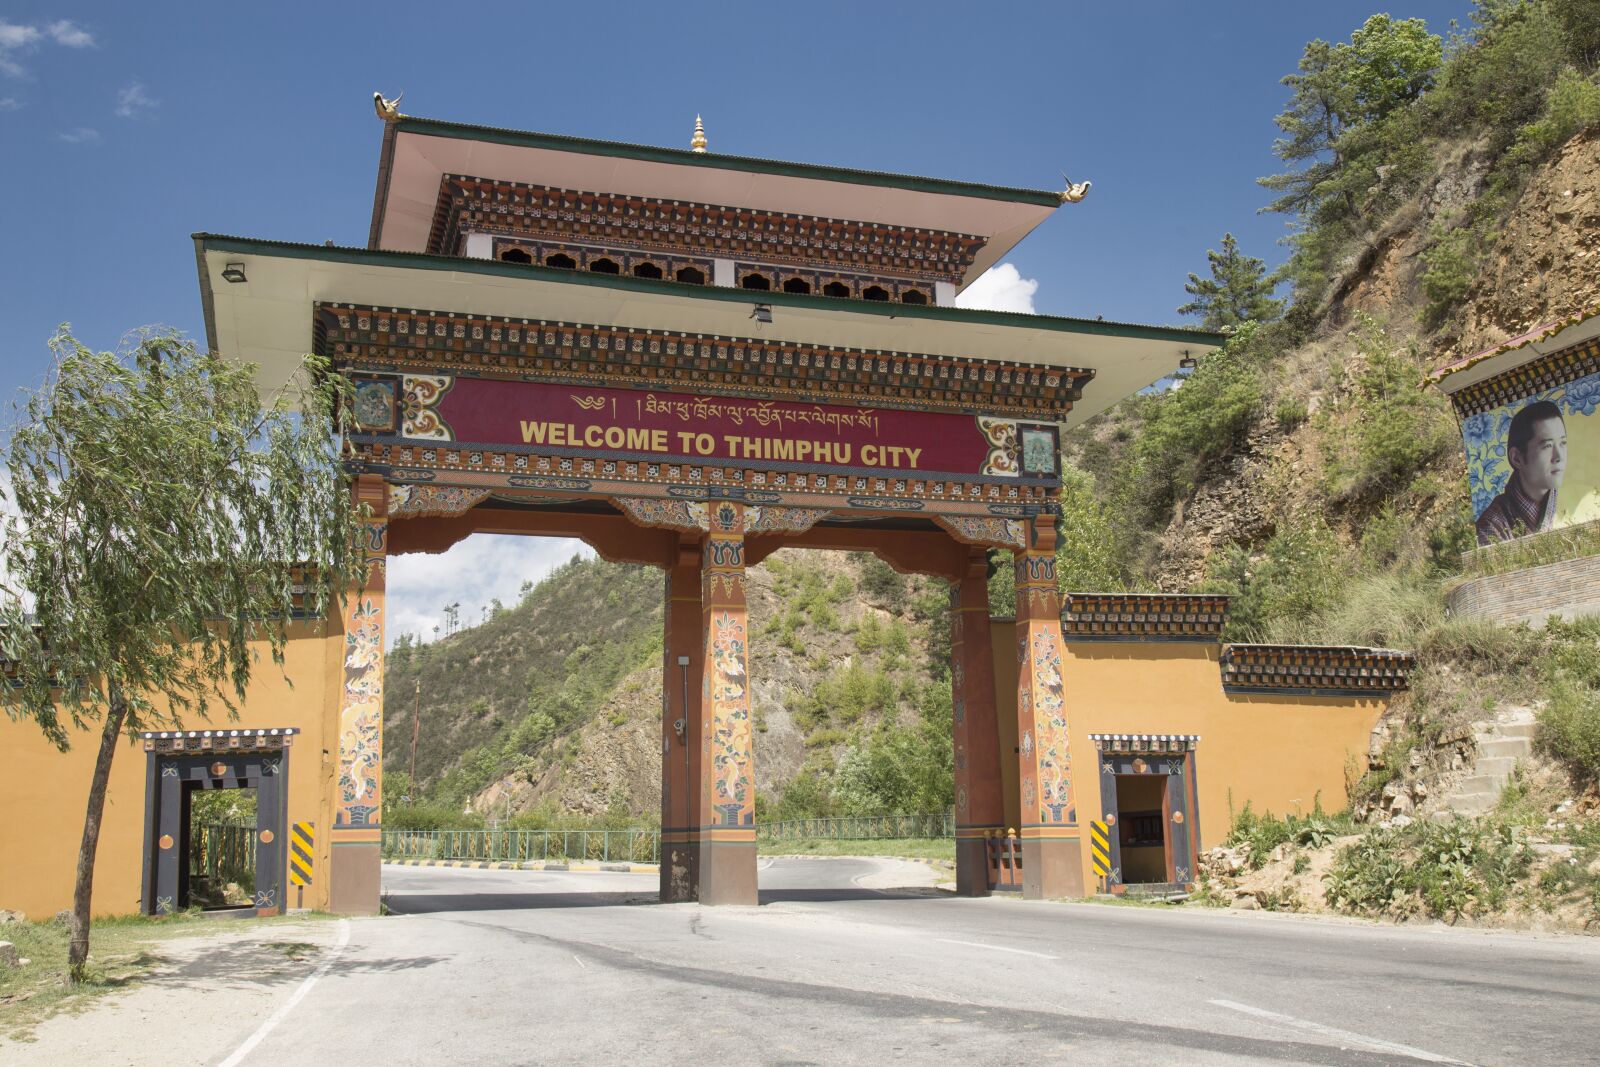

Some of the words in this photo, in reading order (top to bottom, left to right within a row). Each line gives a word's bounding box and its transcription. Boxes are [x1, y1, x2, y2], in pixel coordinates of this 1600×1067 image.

[519, 419, 670, 453] WELCOME
[677, 431, 715, 456] TO
[723, 435, 852, 465] THIMPHU
[860, 444, 922, 468] CITY
